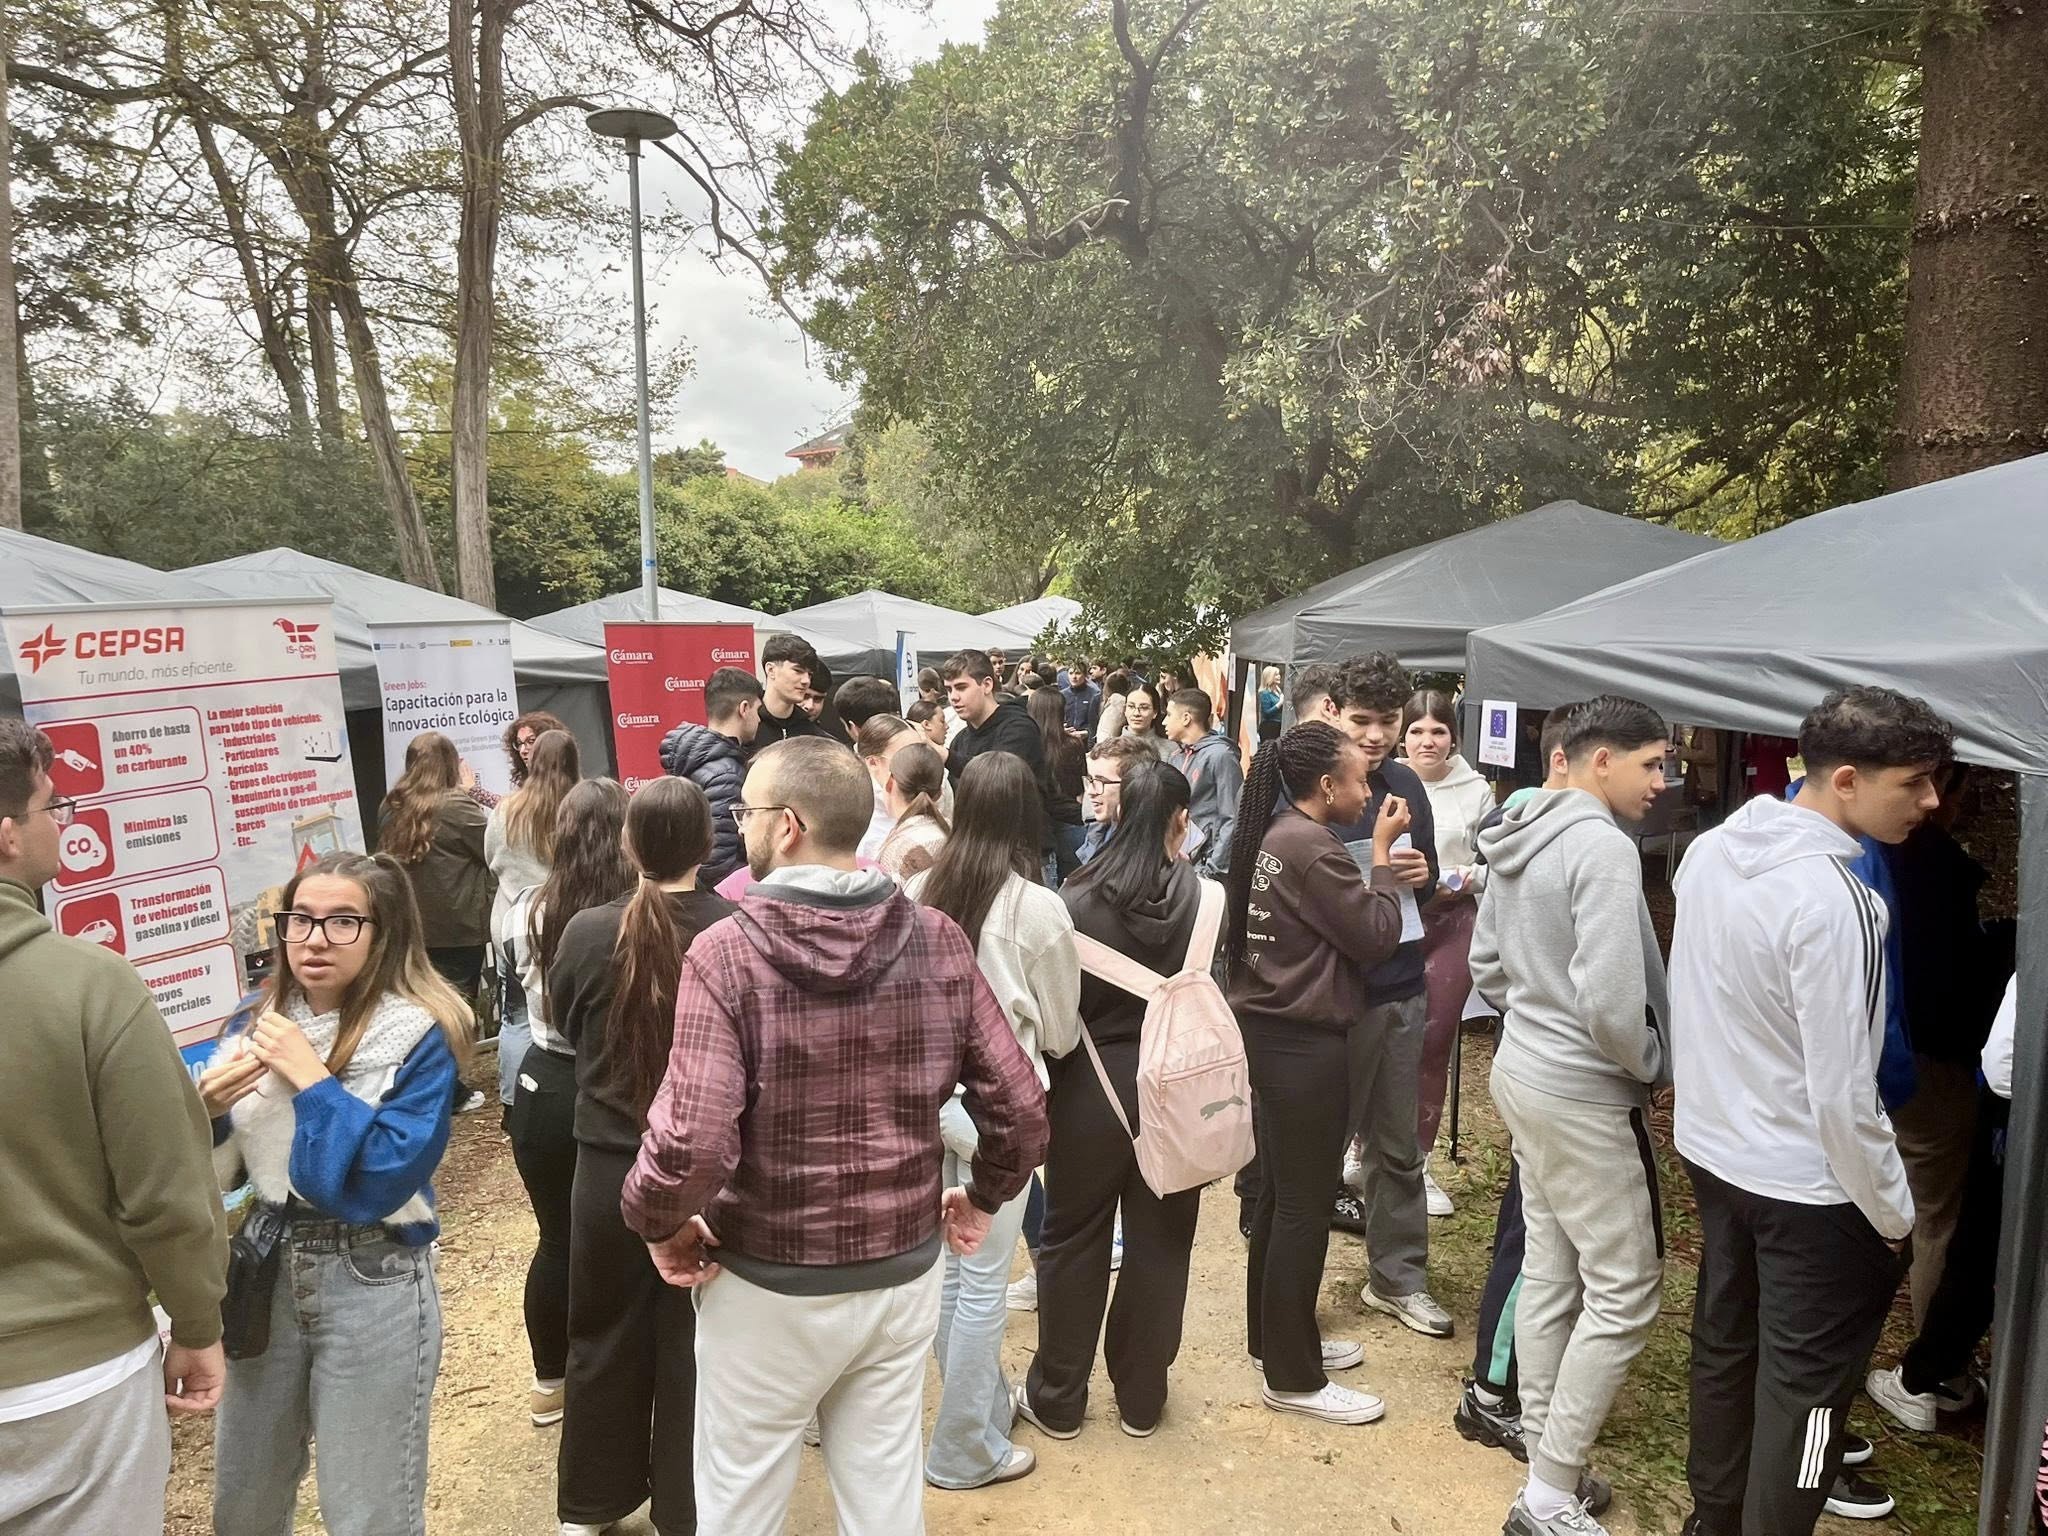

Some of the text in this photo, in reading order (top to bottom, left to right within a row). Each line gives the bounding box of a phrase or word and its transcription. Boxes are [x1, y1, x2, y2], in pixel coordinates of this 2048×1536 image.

[75, 627, 185, 659] CEPSA
[78, 671, 95, 685] Tu
[152, 664, 178, 679] más
[182, 660, 237, 678] eficiente.
[384, 680, 427, 691] Green Jobs:
[386, 688, 508, 714] Capacitación para la
[207, 703, 284, 720] La mejor solución
[388, 708, 515, 733] Innovación Ecológica
[112, 723, 191, 743] Ahorro de hasta
[209, 724, 231, 736] para
[231, 720, 251, 732] todo
[252, 718, 270, 731] tipo
[271, 717, 282, 727] de
[223, 732, 277, 748] Industriales
[114, 743, 153, 759] un 40%
[225, 746, 280, 762] Particulares
[116, 755, 188, 774] en carburante
[229, 768, 318, 791] Grupos electrógenos
[231, 781, 318, 805] Maquinaria a gas-oil
[235, 789, 353, 819] susceptible de transformación
[124, 814, 188, 834] Minimiza las
[235, 819, 266, 833] Barcos
[126, 831, 182, 849] emisiones
[130, 884, 212, 910] Transformación
[133, 914, 147, 926] de
[200, 899, 213, 910] en
[135, 911, 221, 942] gasolina y diesel
[205, 964, 211, 975] y
[160, 995, 212, 1017] merciales
